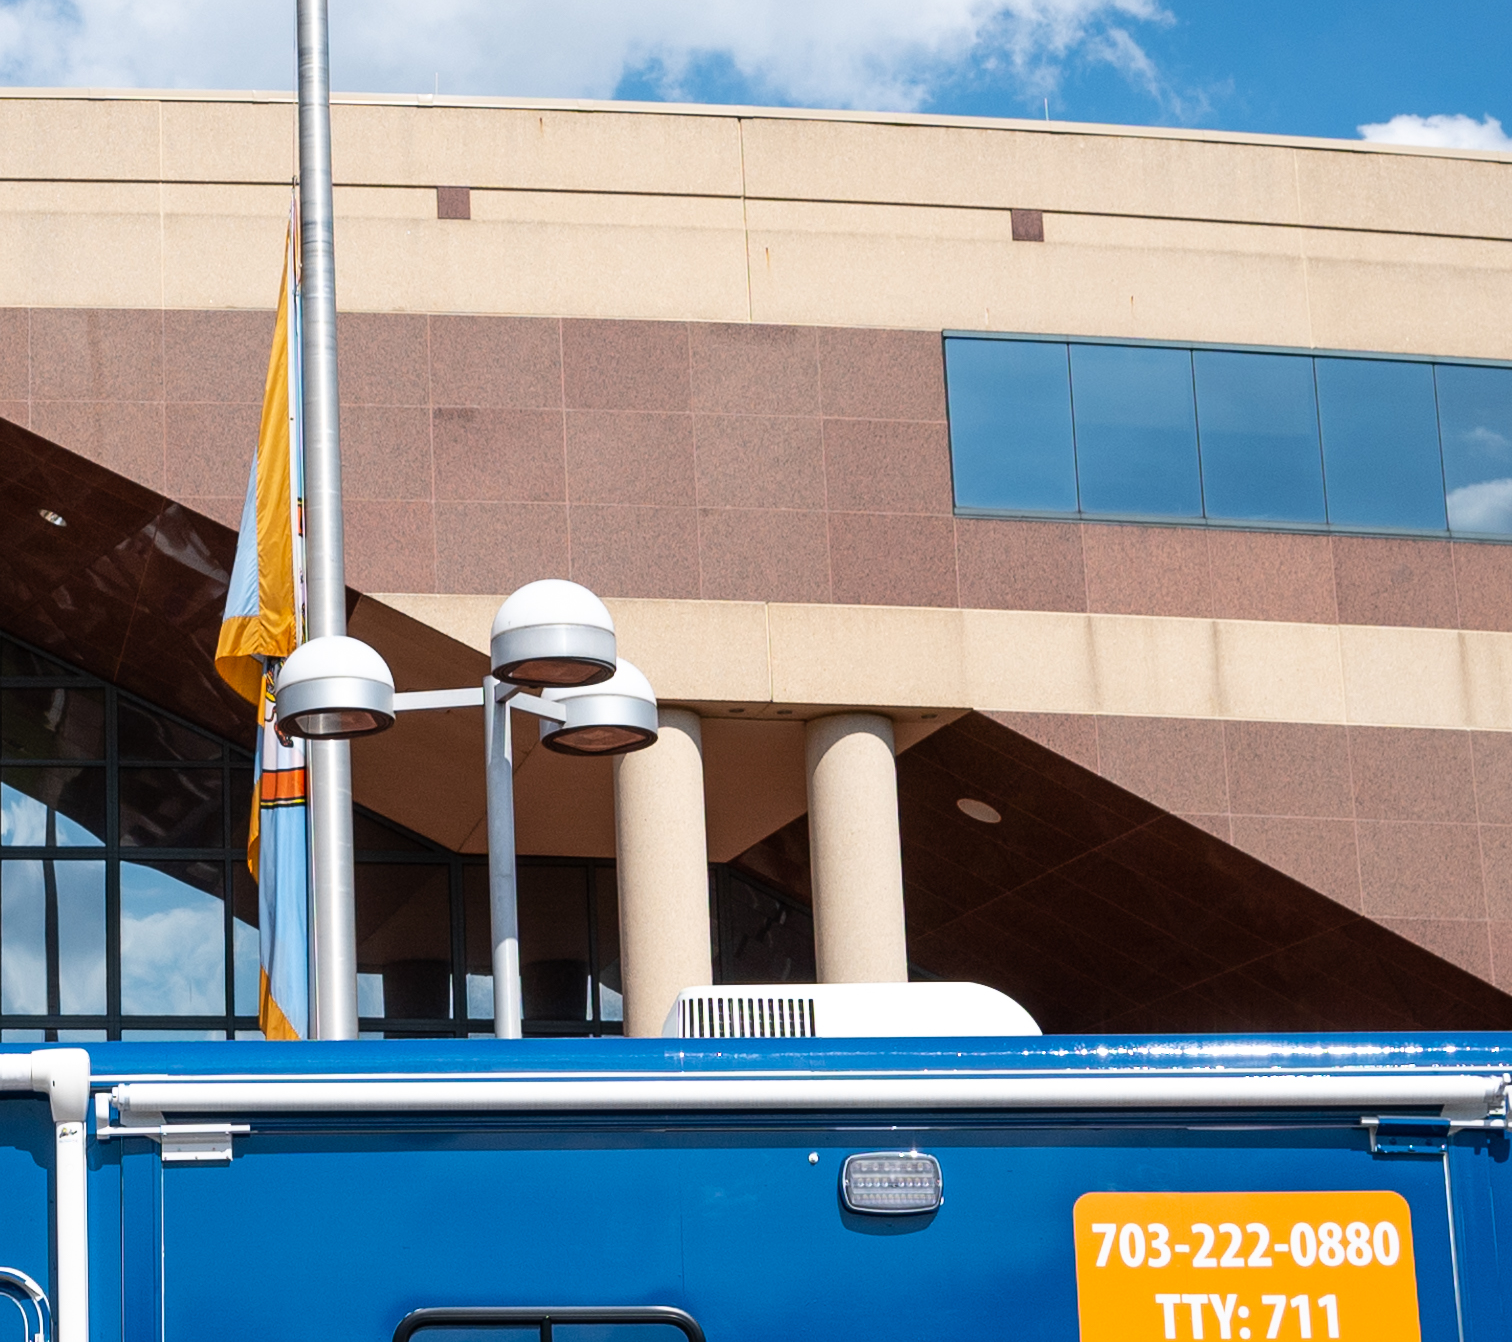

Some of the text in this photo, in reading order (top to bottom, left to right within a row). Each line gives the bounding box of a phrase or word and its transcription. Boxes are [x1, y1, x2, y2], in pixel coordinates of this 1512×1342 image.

[1091, 1221, 1400, 1268] 703-222-0880
[1155, 1293, 1340, 1340] TTY: 711
